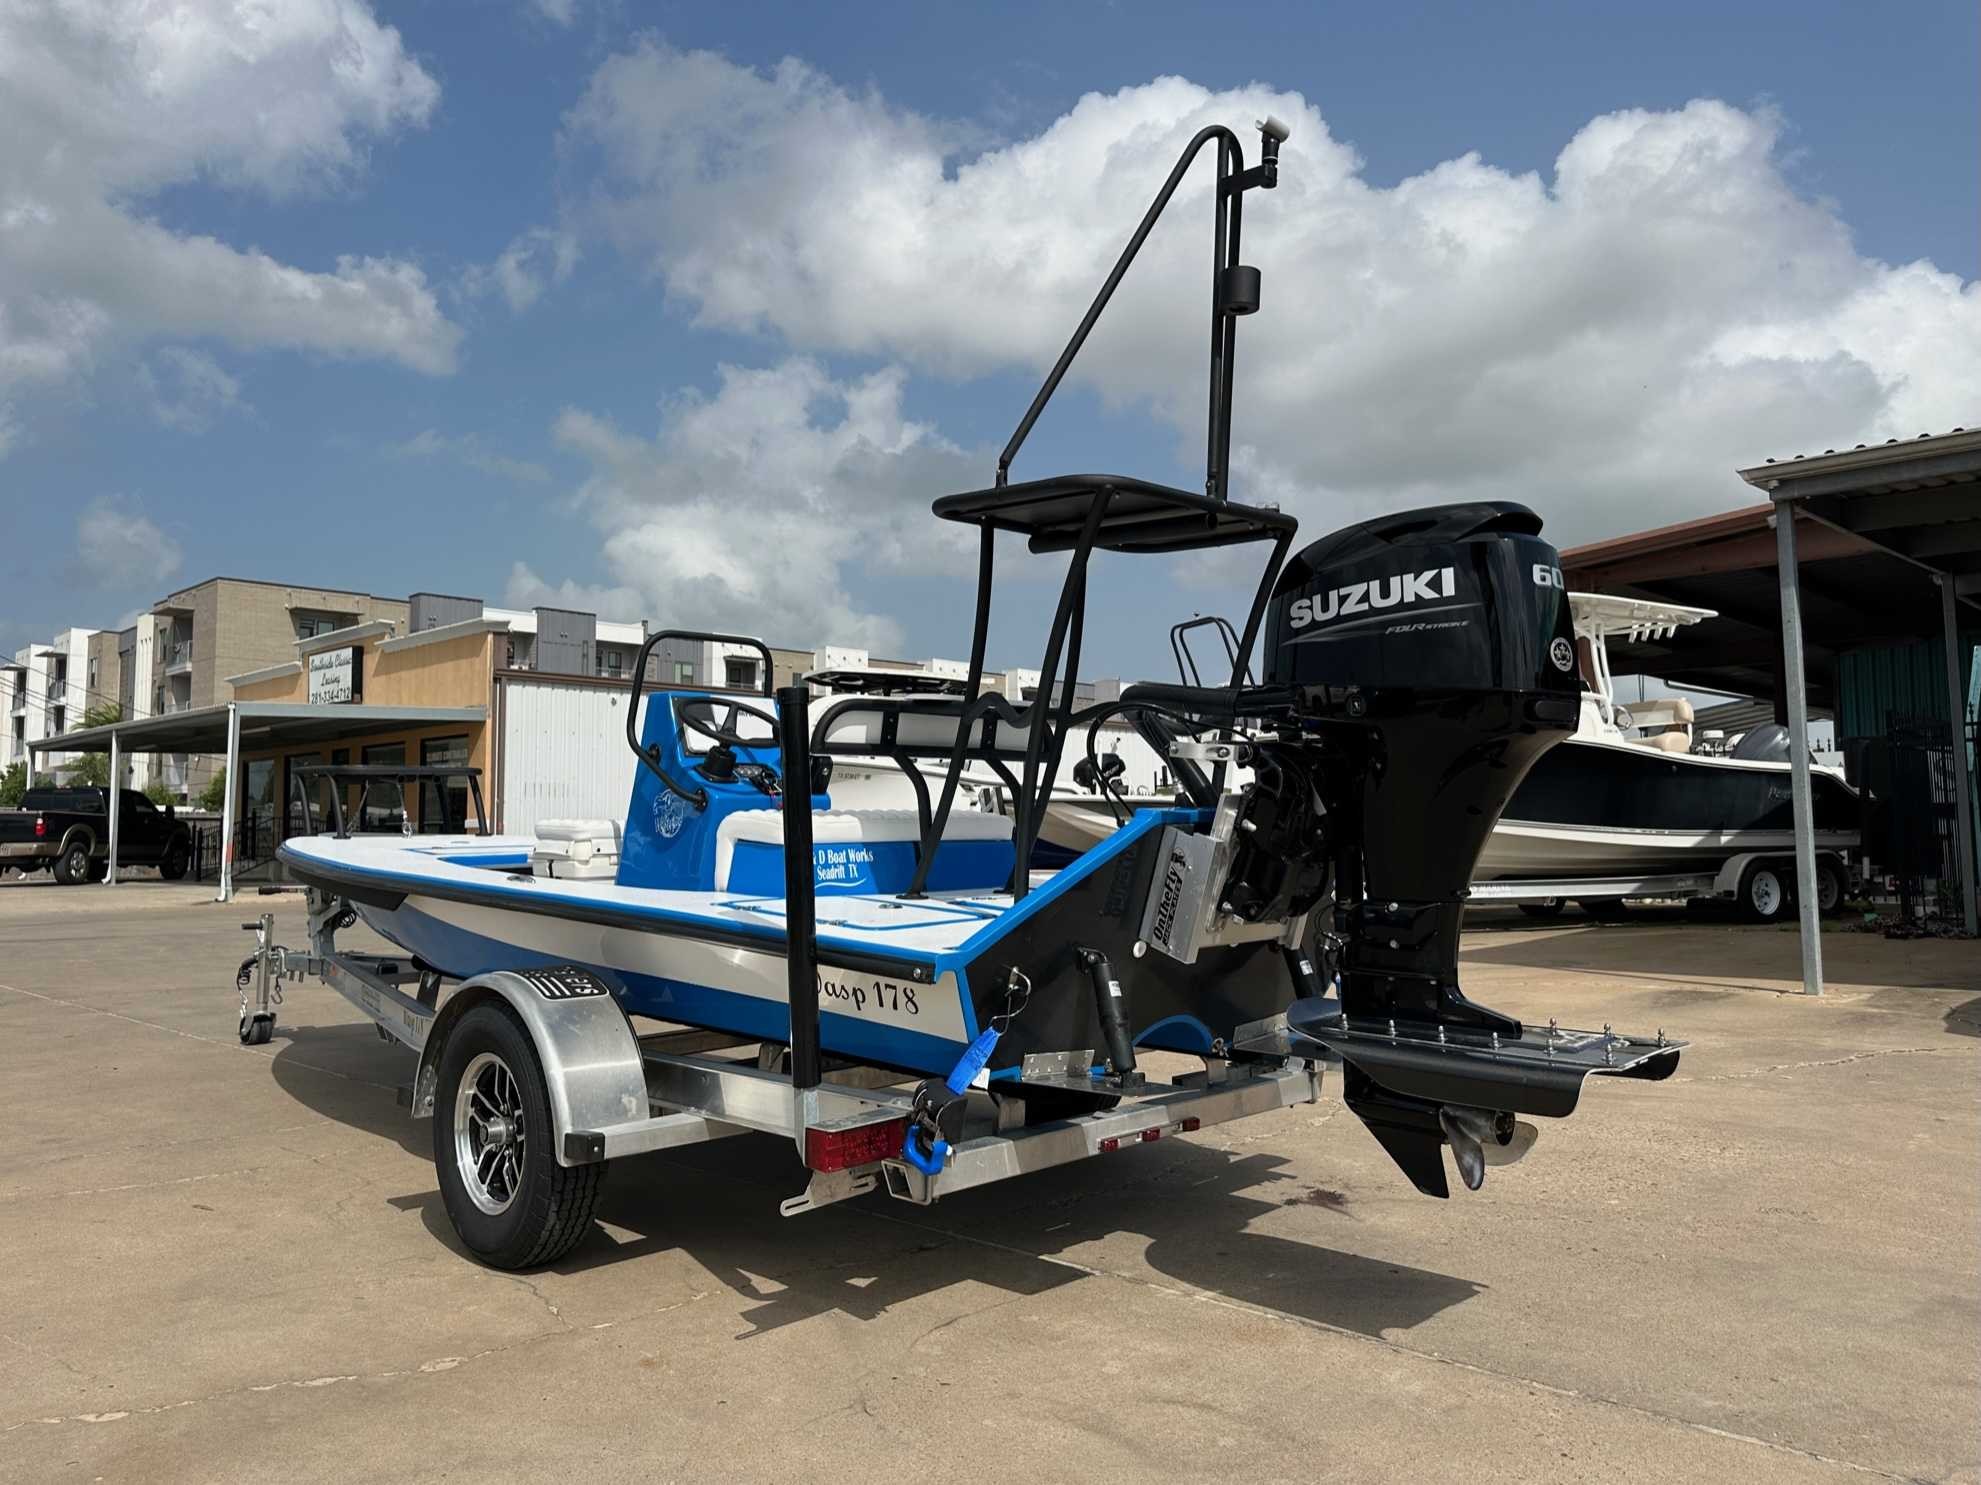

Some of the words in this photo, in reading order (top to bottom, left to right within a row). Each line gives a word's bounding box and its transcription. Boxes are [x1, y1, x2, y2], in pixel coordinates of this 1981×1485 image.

[1533, 563, 1565, 590] 60
[1290, 566, 1456, 629] SUZUKI
[827, 849, 847, 864] Boat
[848, 848, 874, 863] Works
[817, 864, 846, 880] Seadrift
[848, 863, 859, 878] TX
[817, 973, 866, 1011] asp
[873, 981, 919, 1015] 178
